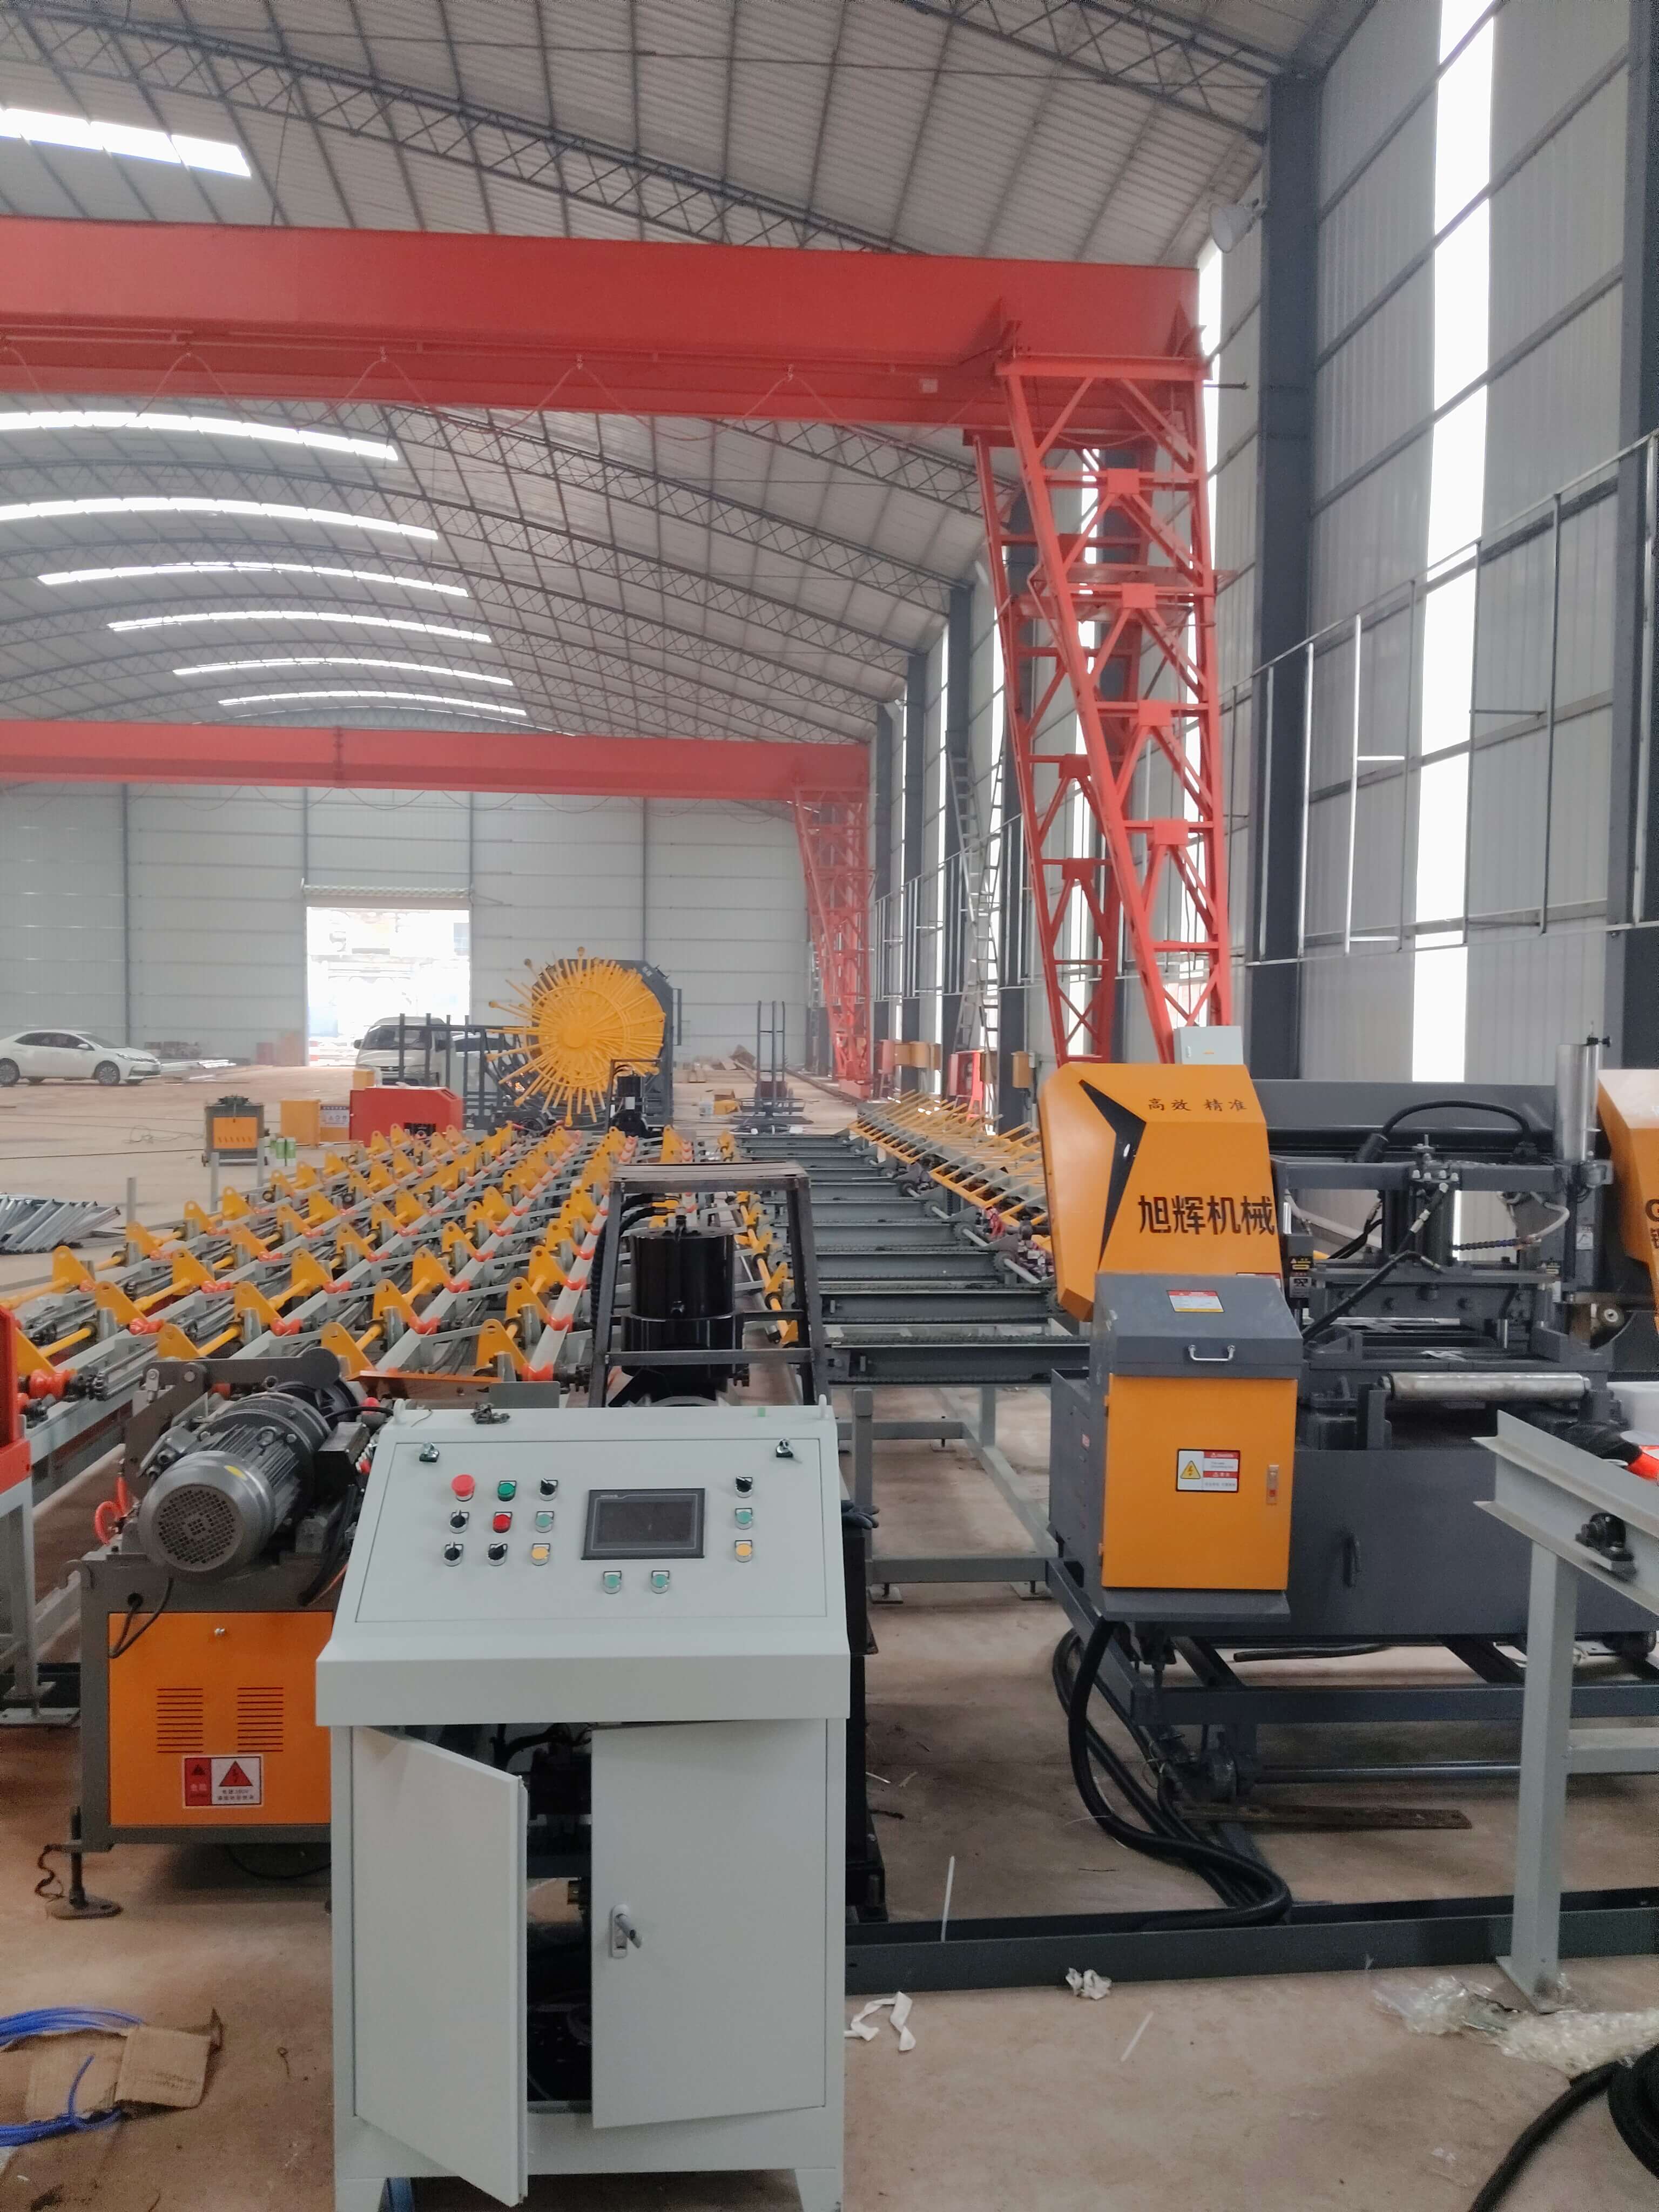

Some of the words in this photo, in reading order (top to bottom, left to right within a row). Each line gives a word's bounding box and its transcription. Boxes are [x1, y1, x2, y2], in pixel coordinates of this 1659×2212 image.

[1148, 1098, 1191, 1111] 高效
[1203, 1098, 1247, 1112] 精准
[1138, 1195, 1276, 1236] 旭辉机械
